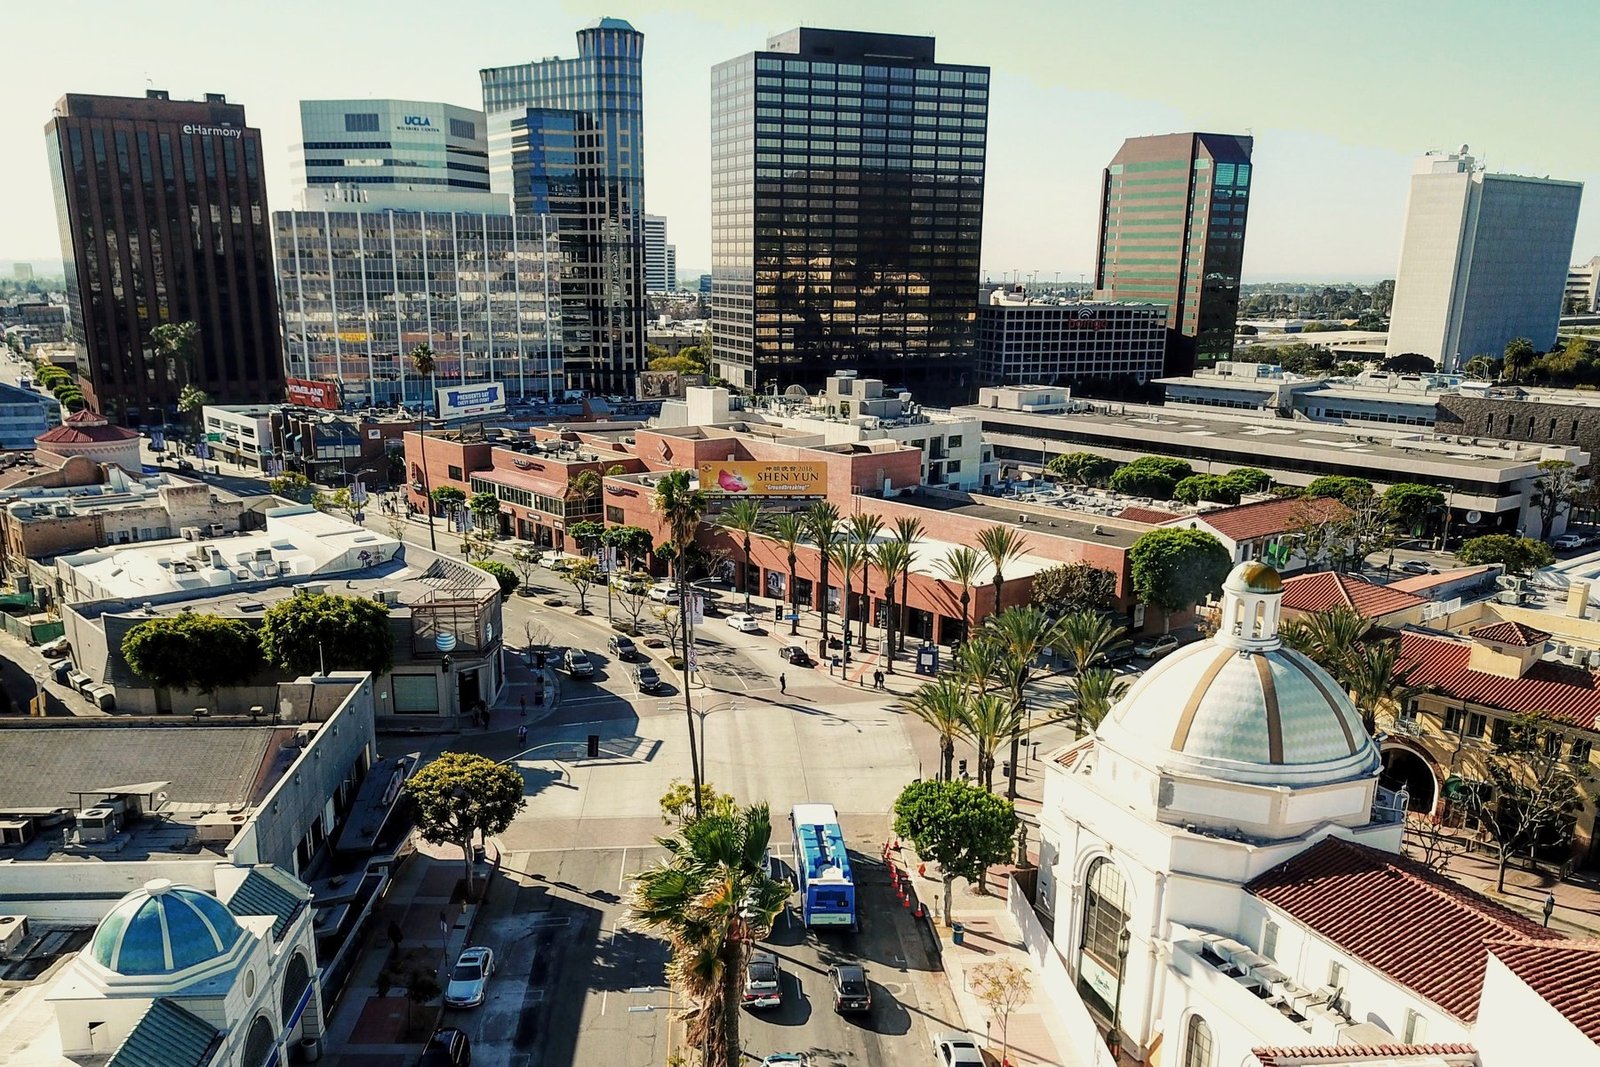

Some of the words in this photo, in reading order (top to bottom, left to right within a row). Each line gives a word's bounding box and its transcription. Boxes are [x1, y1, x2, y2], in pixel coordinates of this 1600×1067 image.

[404, 115, 430, 126] UCLA
[183, 124, 242, 139] eHarmony
[288, 384, 324, 397] HOMELAND
[757, 472, 789, 482] SHEN
[792, 472, 820, 482] YUN
